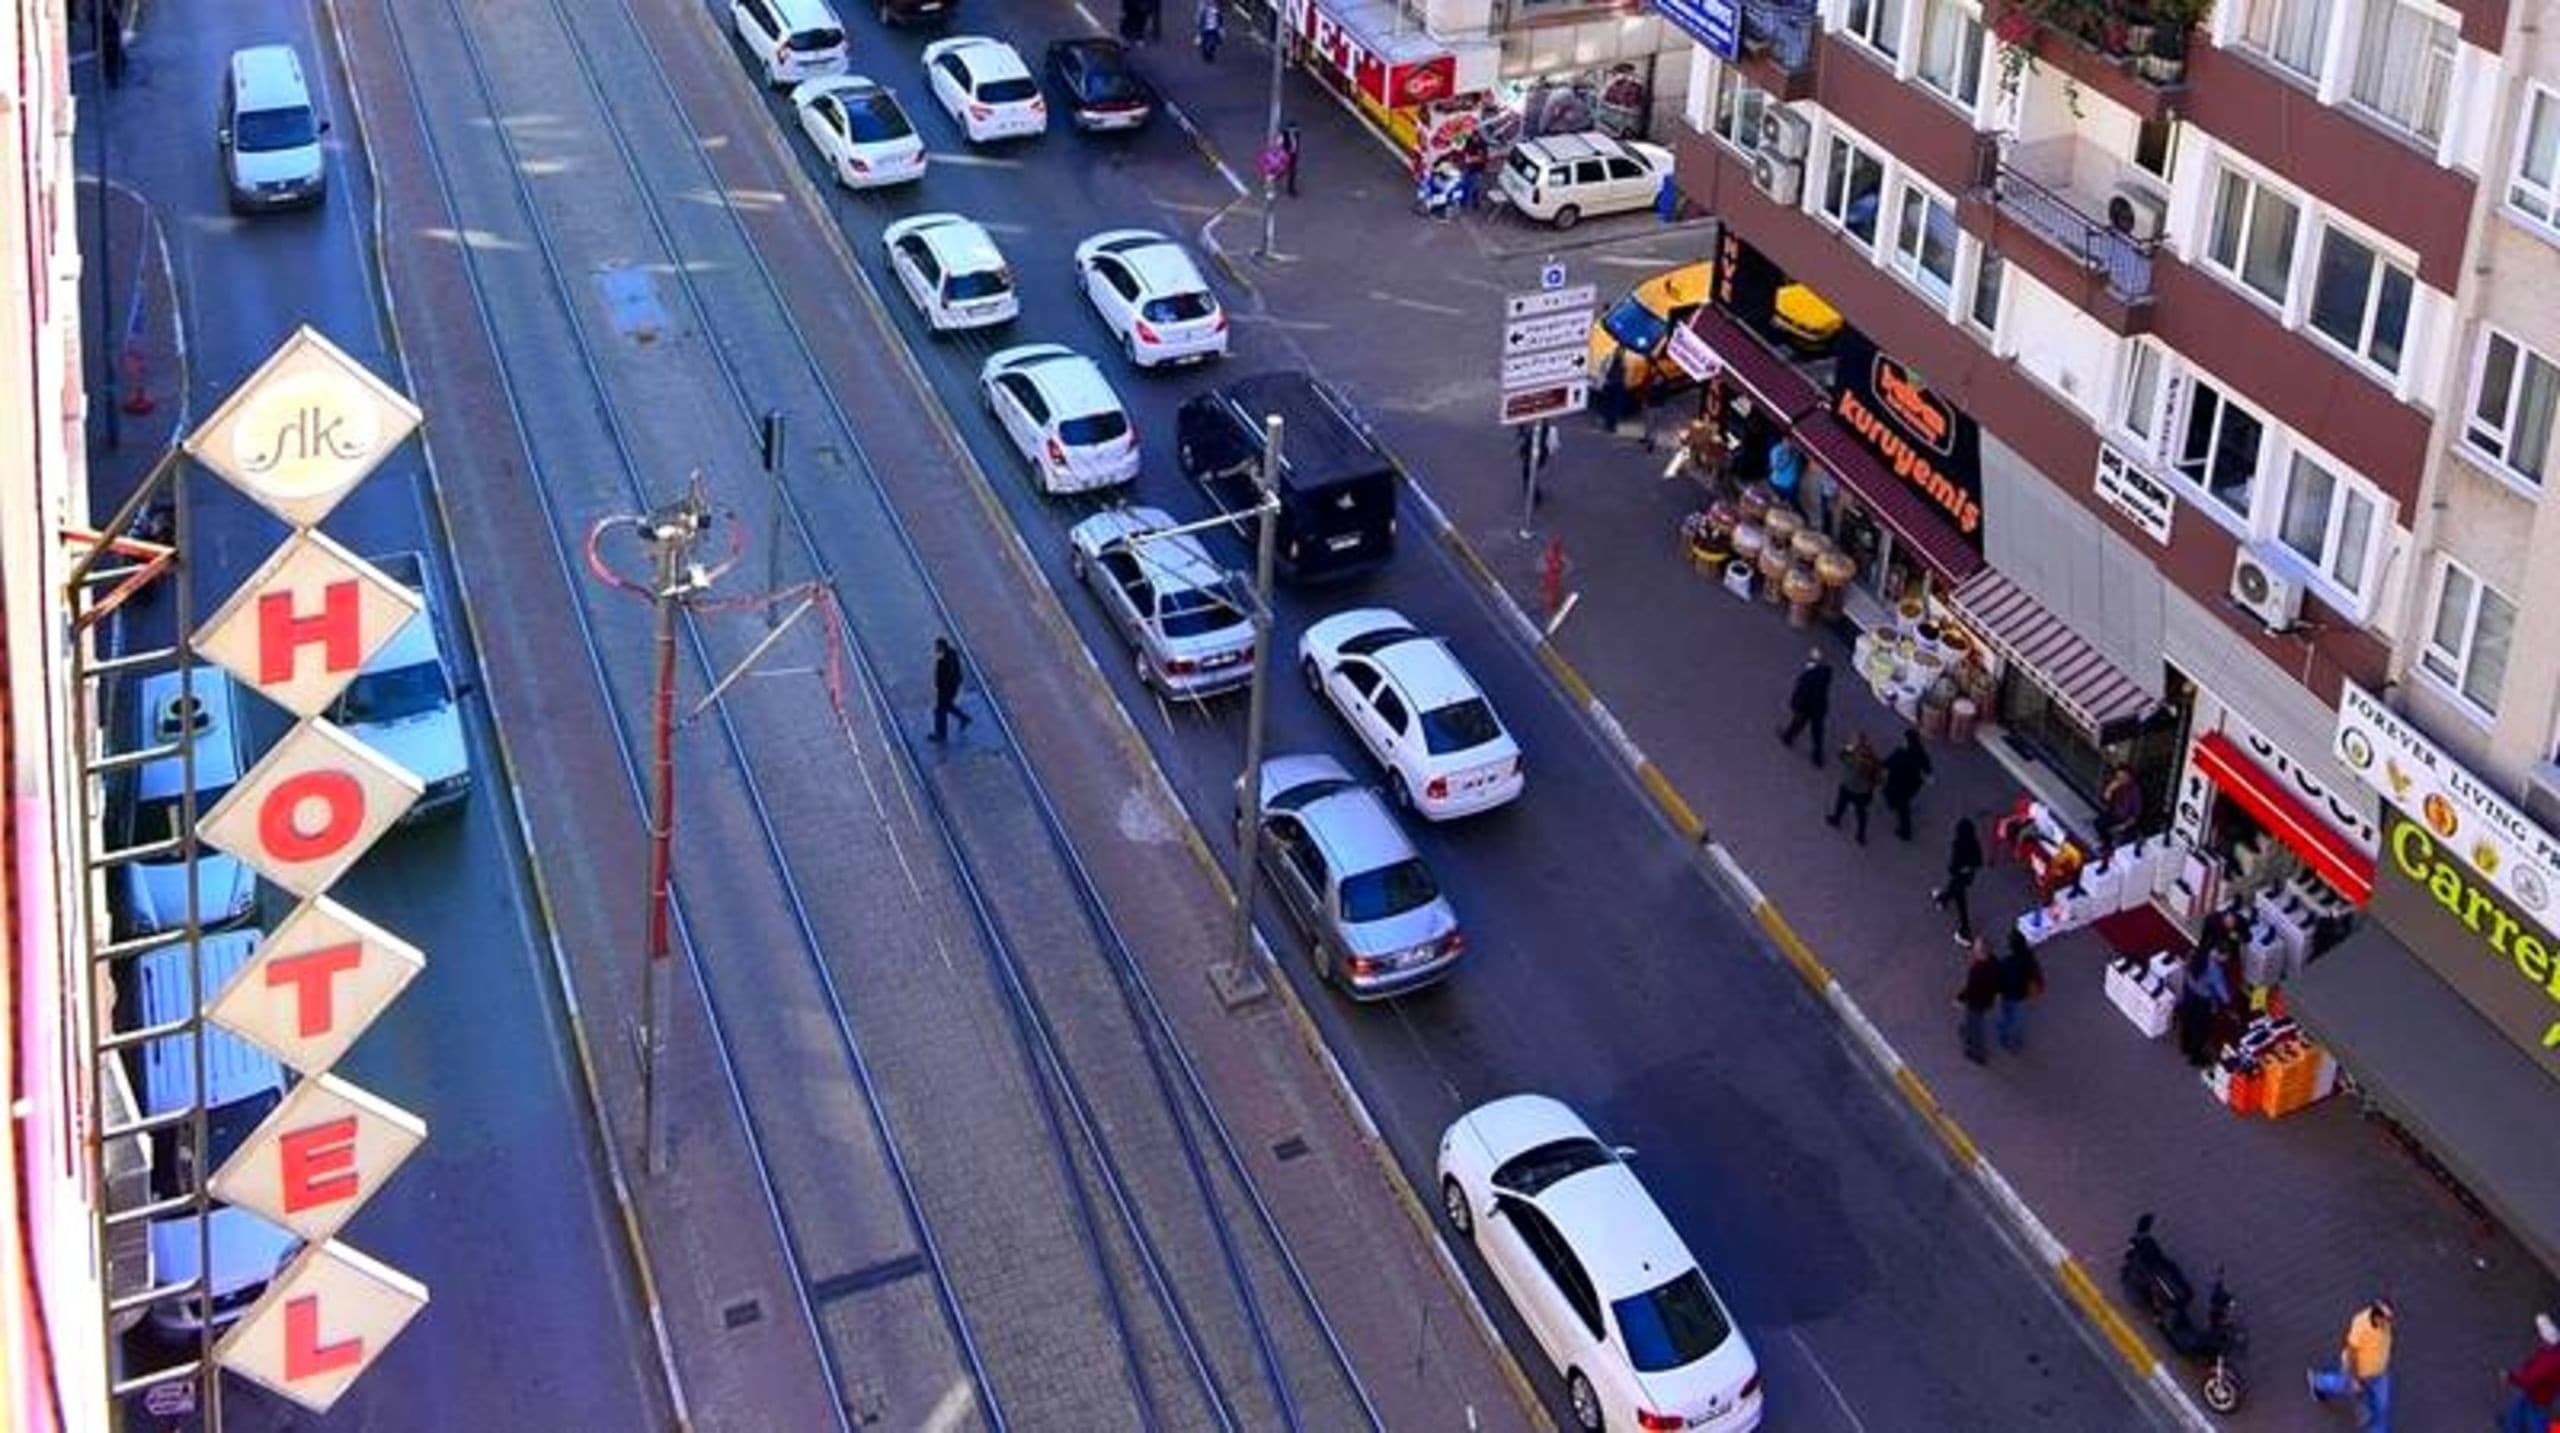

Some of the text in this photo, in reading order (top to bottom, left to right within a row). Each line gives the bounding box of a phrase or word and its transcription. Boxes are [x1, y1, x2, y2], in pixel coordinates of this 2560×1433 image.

[257, 579, 366, 1383] HOTEL
[2348, 690, 2437, 772] FOREVER
[2450, 769, 2529, 842] LIVING
